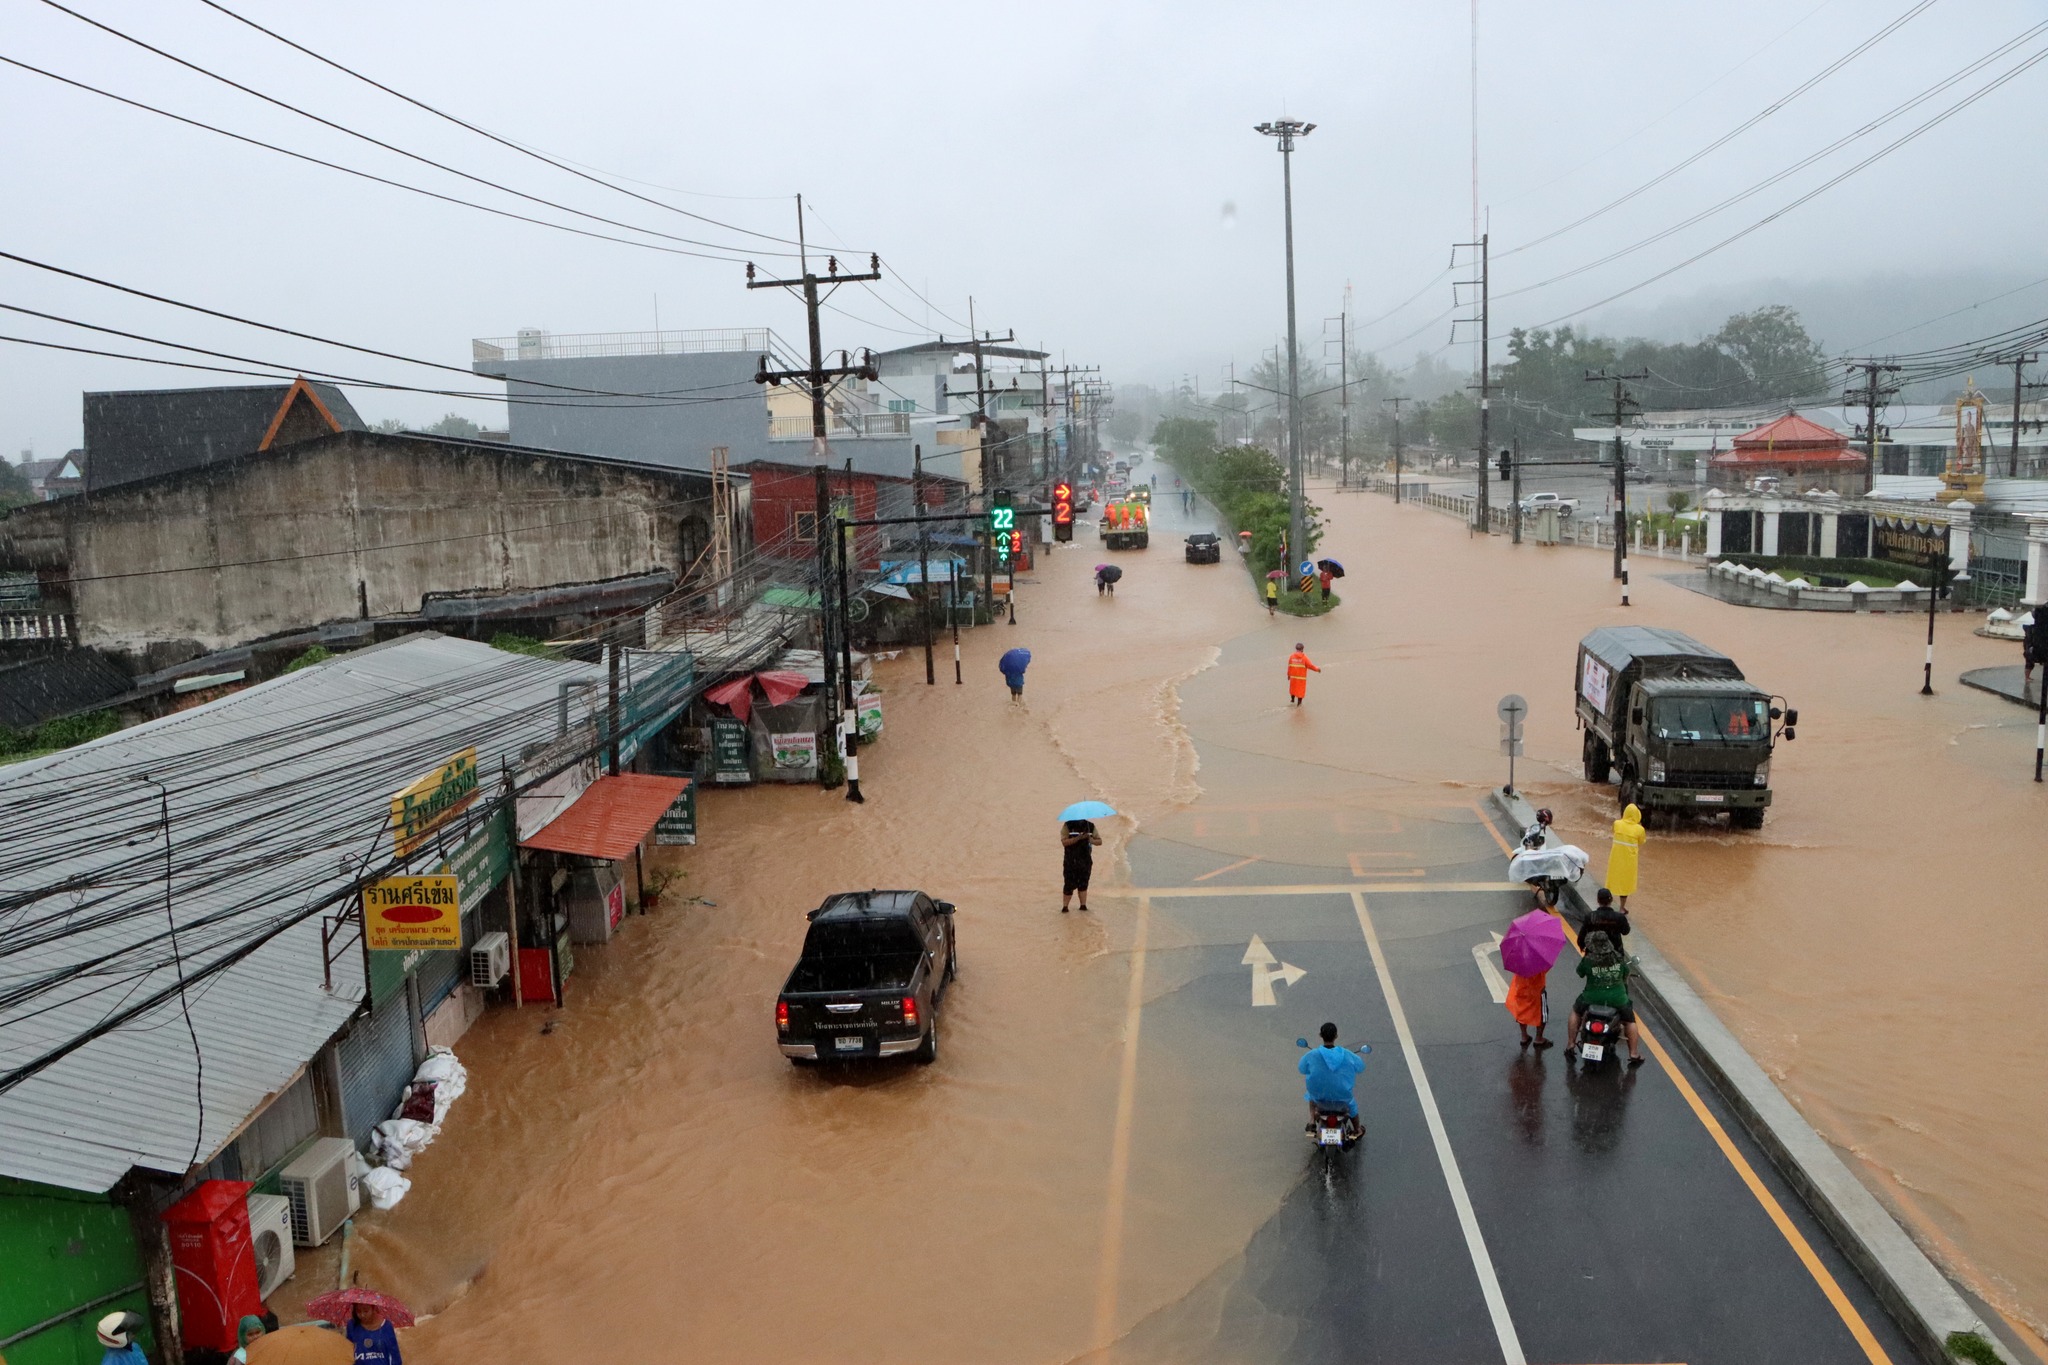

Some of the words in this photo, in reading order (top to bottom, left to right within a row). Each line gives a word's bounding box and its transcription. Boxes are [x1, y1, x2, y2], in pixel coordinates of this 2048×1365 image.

[994, 508, 1013, 528] 22
[1057, 502, 1070, 522] 2
[1012, 541, 1020, 552] 2
[368, 879, 454, 905] ร้านศรีเข้ม
[389, 924, 429, 934] เครื่องหมาย
